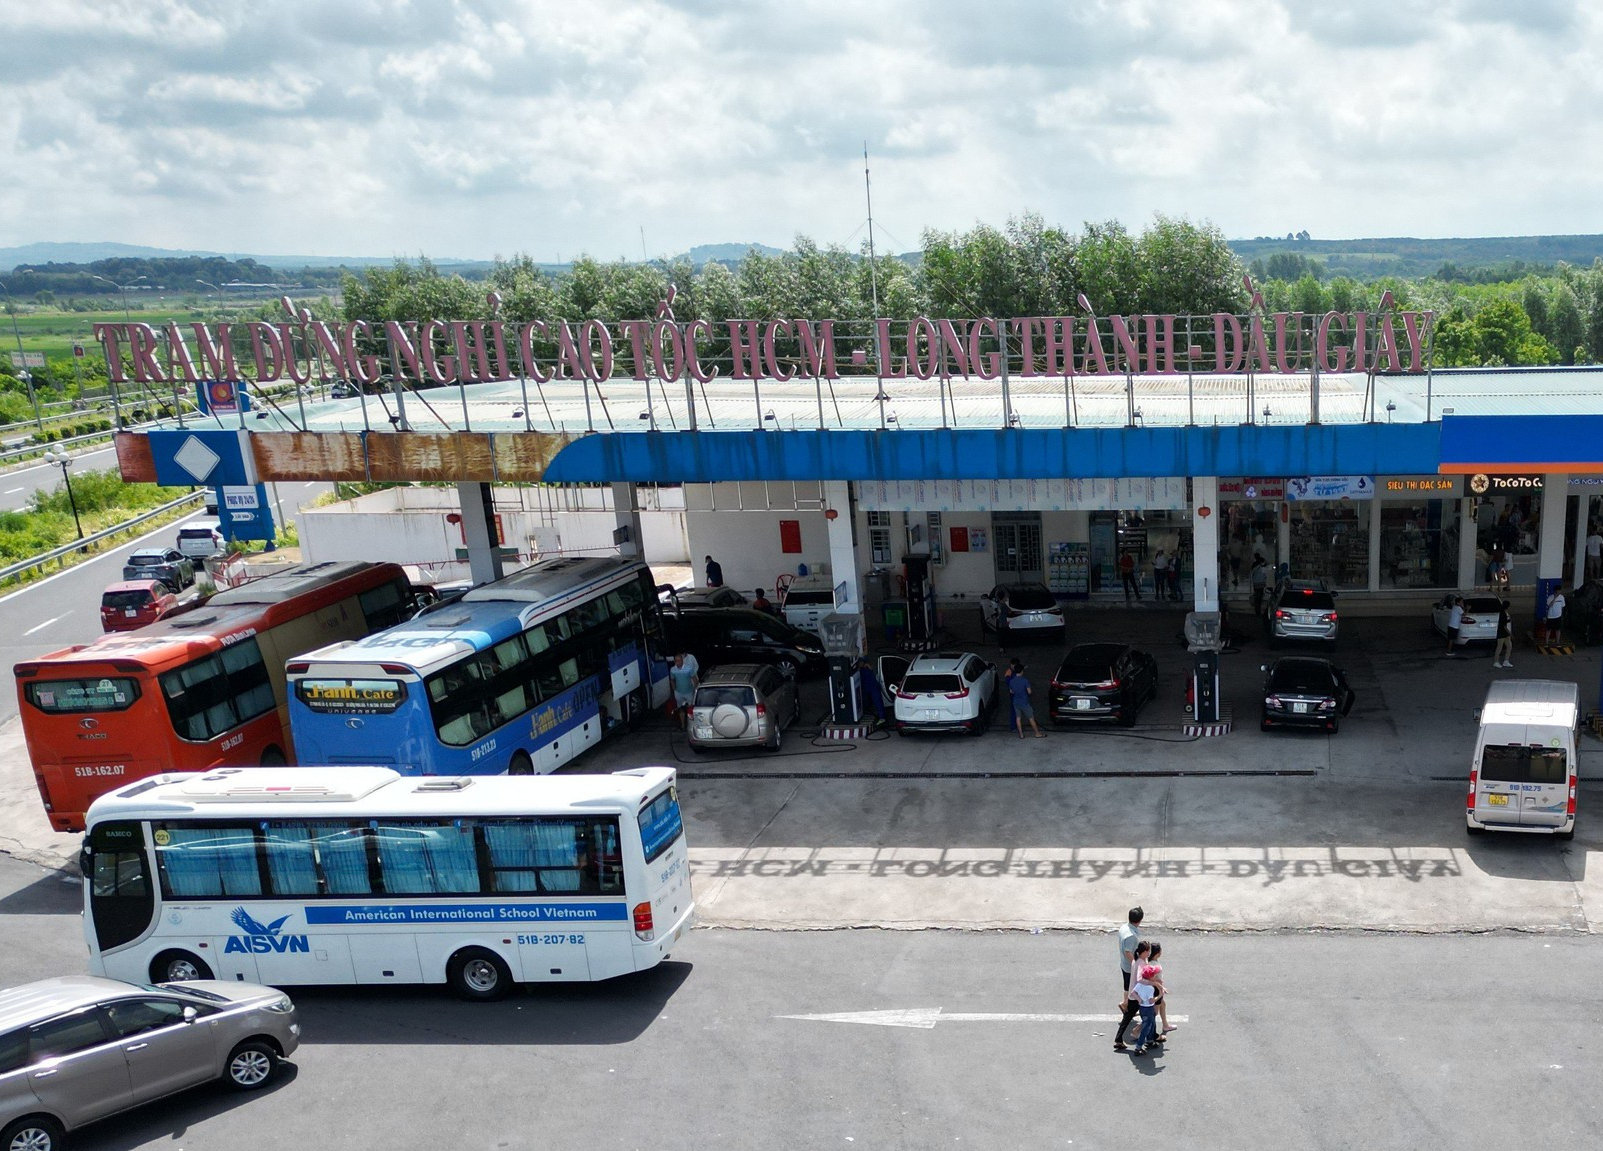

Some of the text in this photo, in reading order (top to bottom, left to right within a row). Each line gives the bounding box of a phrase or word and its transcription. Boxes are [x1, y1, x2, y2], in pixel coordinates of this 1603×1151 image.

[520, 318, 616, 384] CAO
[620, 283, 720, 384] TỐC
[725, 317, 841, 383] HCM
[875, 315, 1003, 381] LONG
[1010, 292, 1178, 377] THÀNH
[1211, 275, 1304, 375] DẦU
[75, 765, 125, 777] 51B-162.07
[156, 833, 169, 841] 221
[345, 907, 597, 920] American International School Vietnam
[224, 936, 310, 954] AISVN
